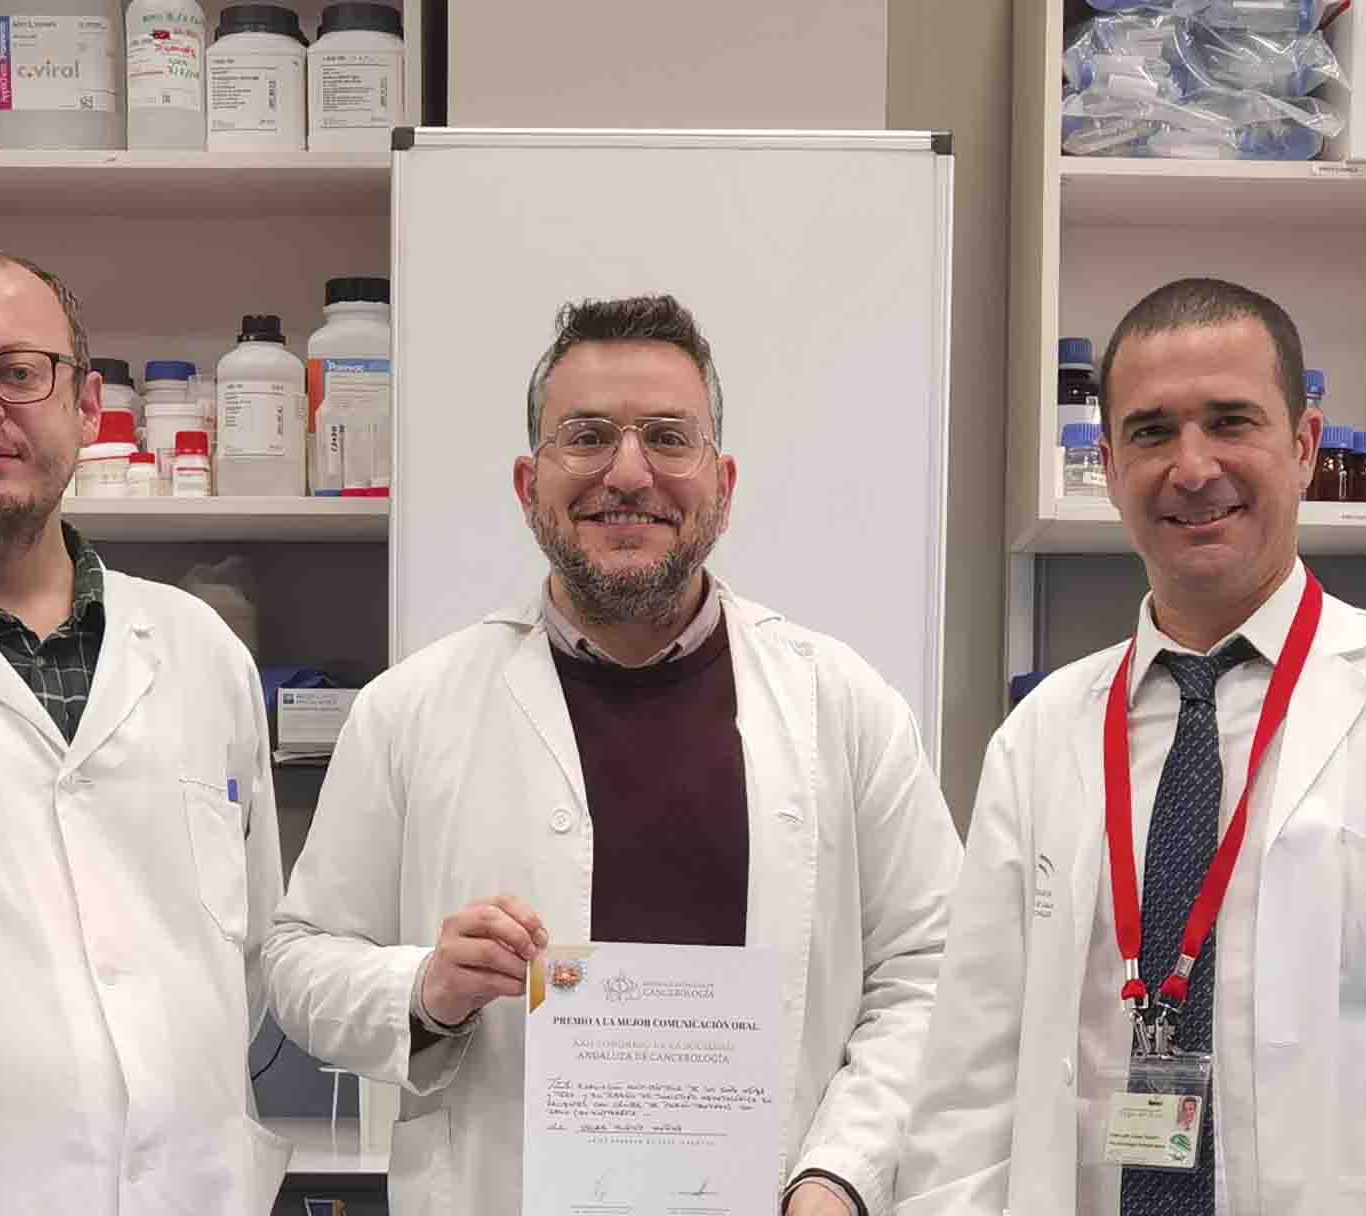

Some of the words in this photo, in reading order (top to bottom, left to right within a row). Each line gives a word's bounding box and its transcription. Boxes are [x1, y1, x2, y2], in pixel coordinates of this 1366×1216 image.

[553, 1015, 593, 1027] PREMIO
[603, 1017, 618, 1027] LA
[618, 1017, 651, 1029] MEJOR
[652, 1017, 730, 1031] COMUNICACIÓN
[731, 1020, 760, 1031] ORAL
